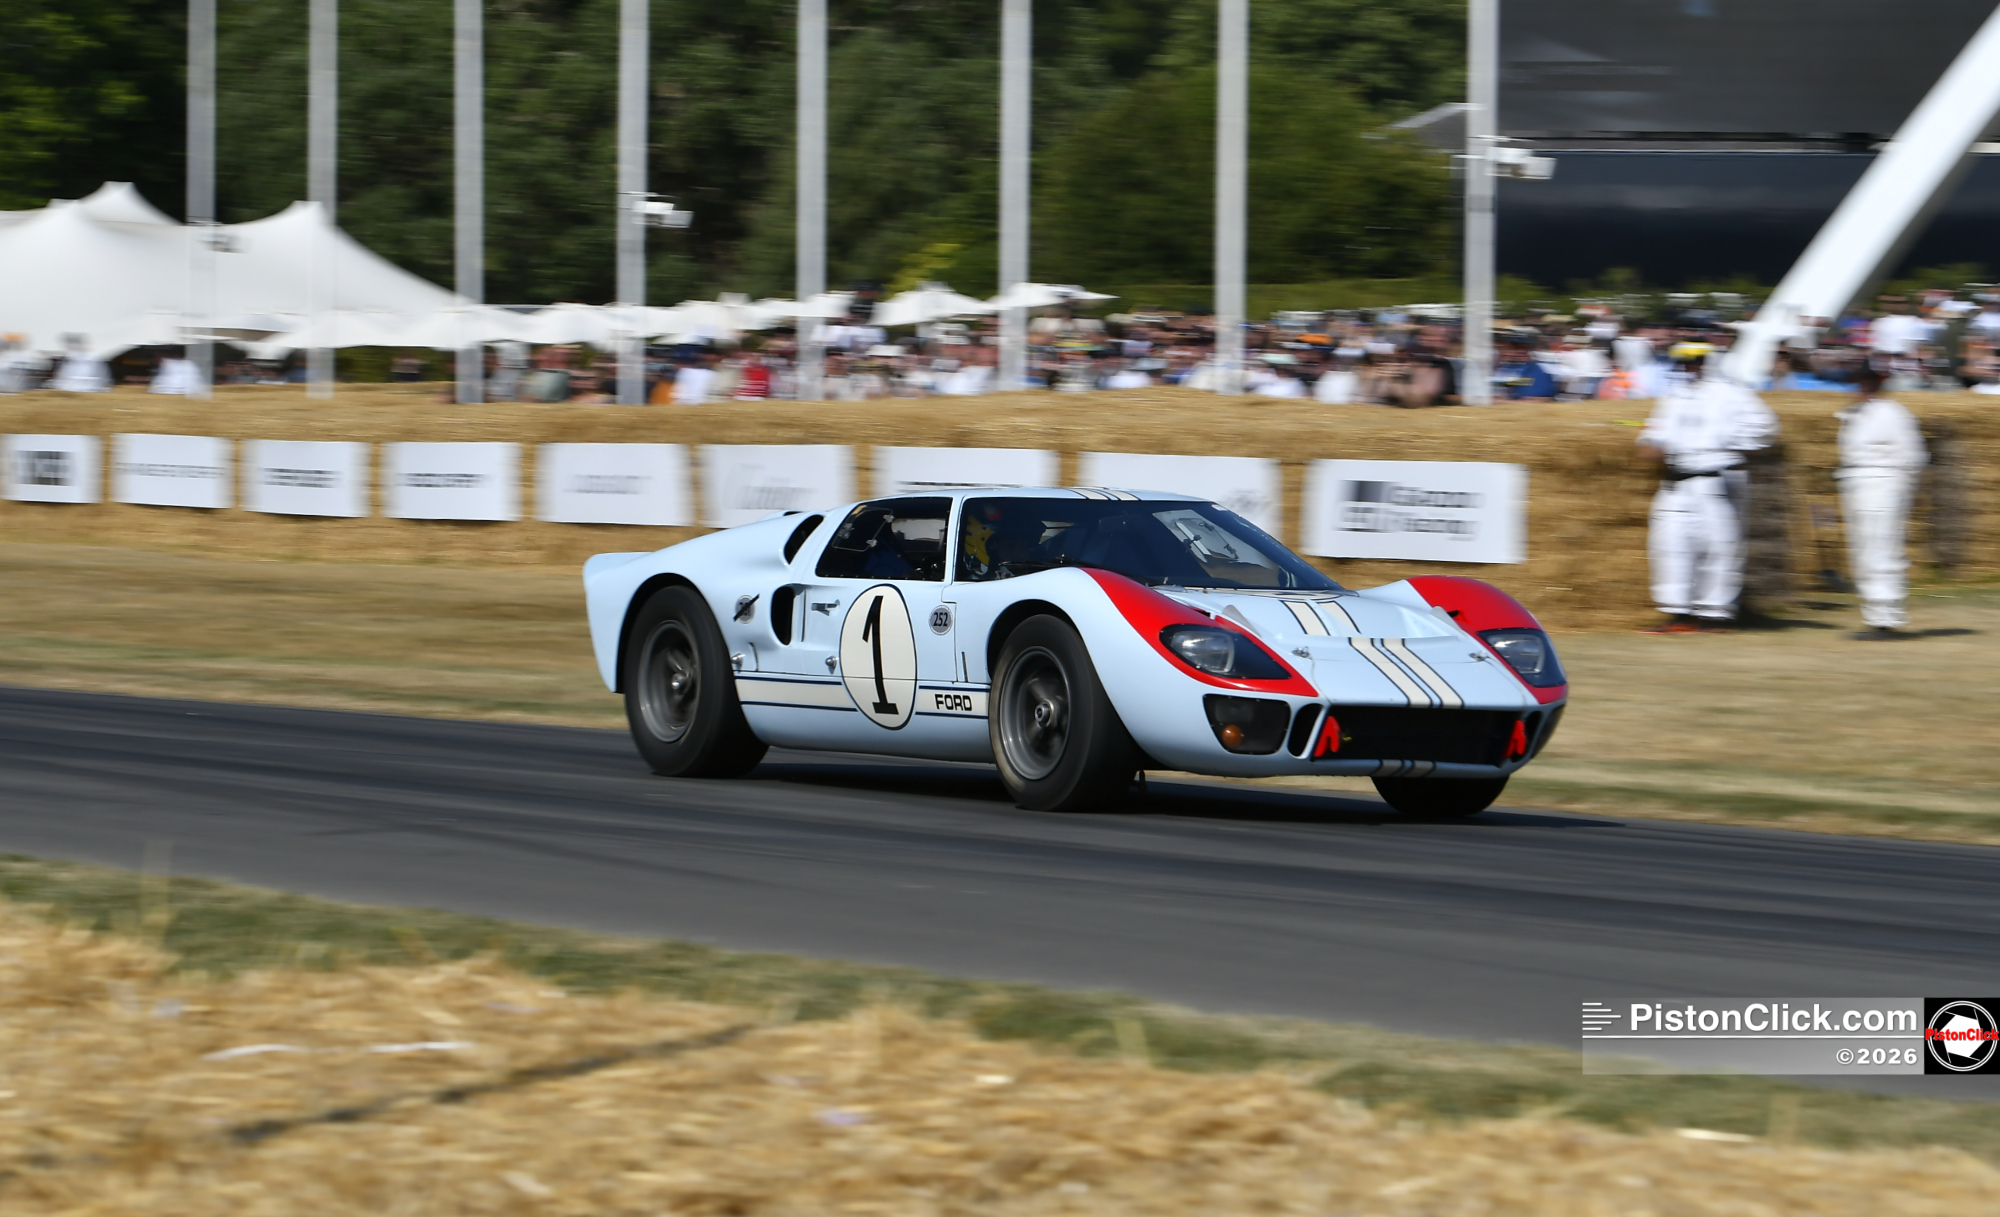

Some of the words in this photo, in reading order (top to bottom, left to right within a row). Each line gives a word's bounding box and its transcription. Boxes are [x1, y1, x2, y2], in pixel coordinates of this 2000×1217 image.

[933, 612, 948, 627] 252
[862, 595, 899, 715] 1
[934, 693, 973, 711] FORD
